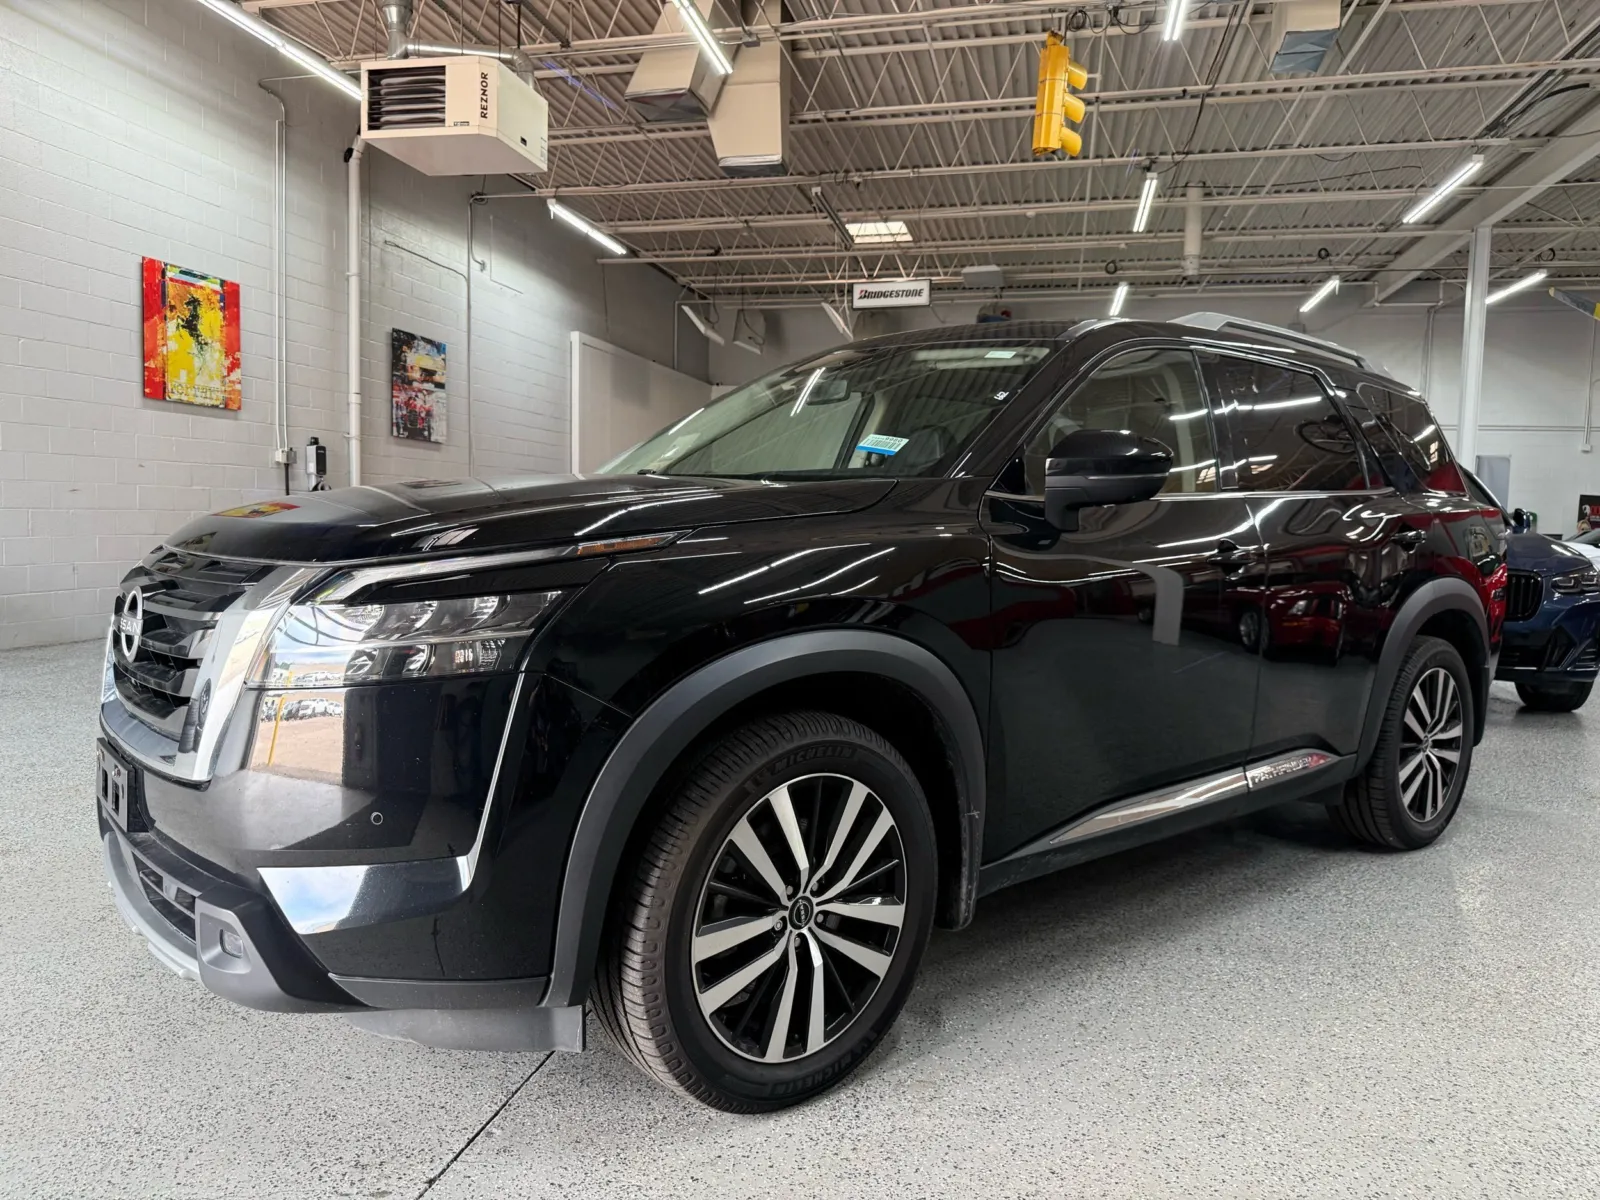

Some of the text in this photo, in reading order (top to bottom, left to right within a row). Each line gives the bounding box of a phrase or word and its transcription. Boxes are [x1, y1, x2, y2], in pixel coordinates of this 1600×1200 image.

[480, 72, 489, 119] REZNOR
[858, 288, 925, 300] BRIDGESTONE
[773, 745, 853, 775] MICHELIN
[773, 1053, 854, 1096] MICHELIN
